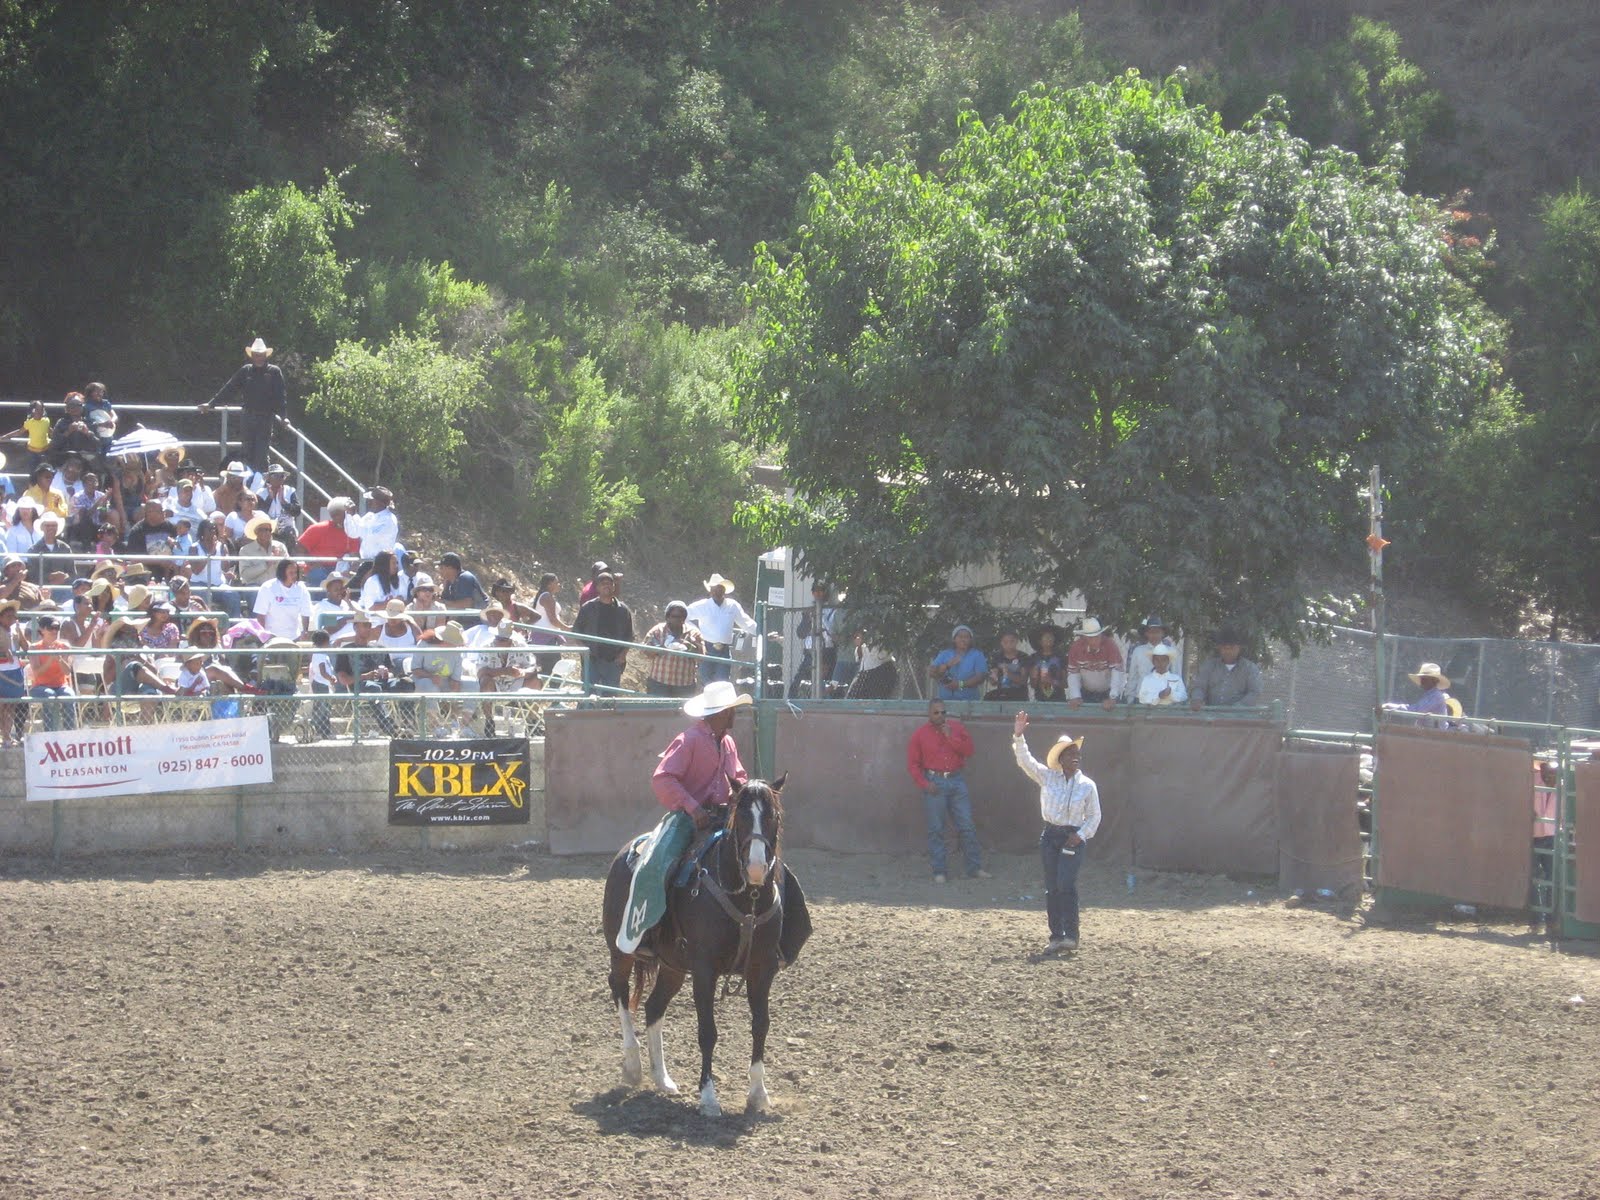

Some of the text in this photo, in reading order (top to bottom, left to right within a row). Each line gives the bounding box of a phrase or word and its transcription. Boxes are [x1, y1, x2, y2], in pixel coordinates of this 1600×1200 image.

[39, 735, 132, 766] Marriott
[50, 764, 128, 778] PLEASANTON
[158, 759, 192, 775] (925)
[195, 757, 219, 770] 847
[231, 753, 264, 768] 6000
[394, 760, 526, 809] KBLX
[395, 797, 510, 814] The Quiet Storm
[430, 814, 490, 822] www.kblx.com
